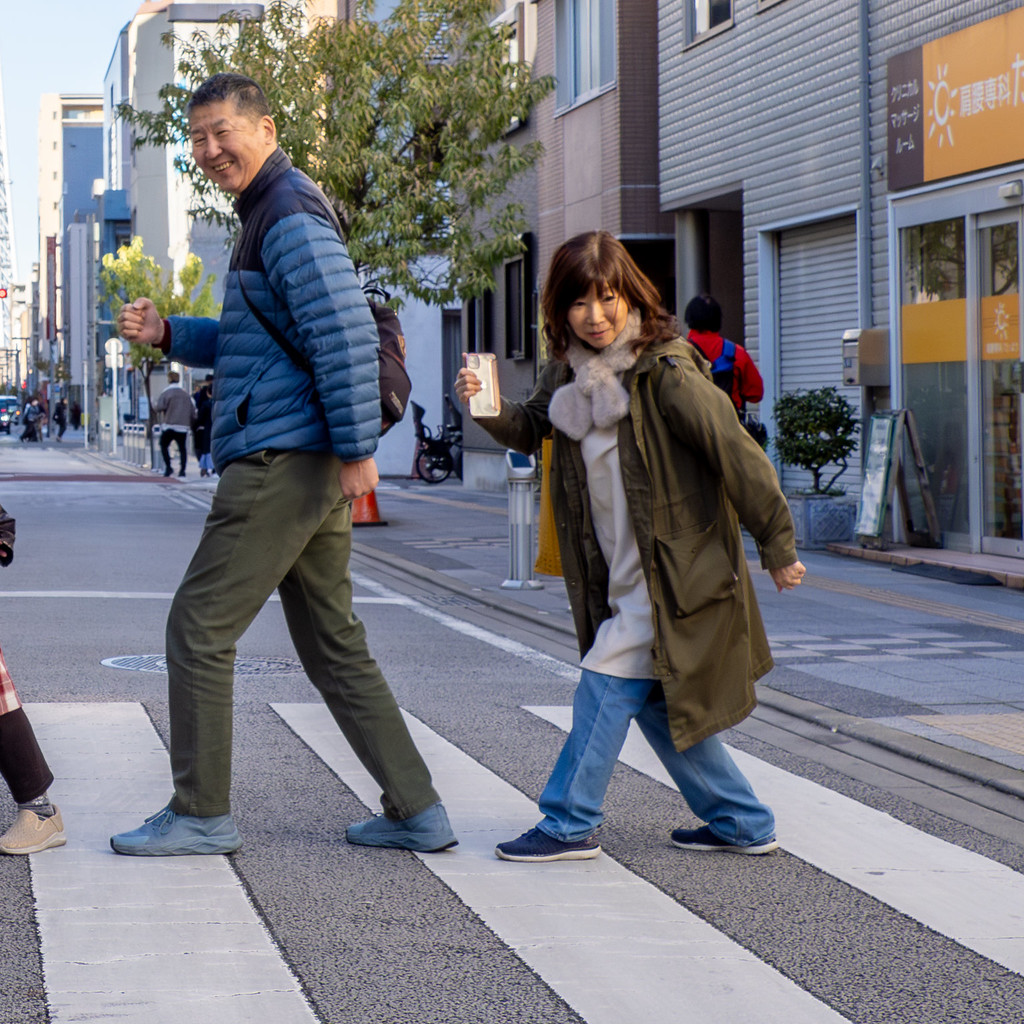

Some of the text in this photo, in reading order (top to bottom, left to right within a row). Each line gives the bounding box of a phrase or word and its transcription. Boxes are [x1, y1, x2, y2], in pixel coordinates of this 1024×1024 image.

[959, 72, 1011, 118] 肩腰専科
[890, 104, 920, 128] マッサージ
[895, 133, 915, 154] ルーム
